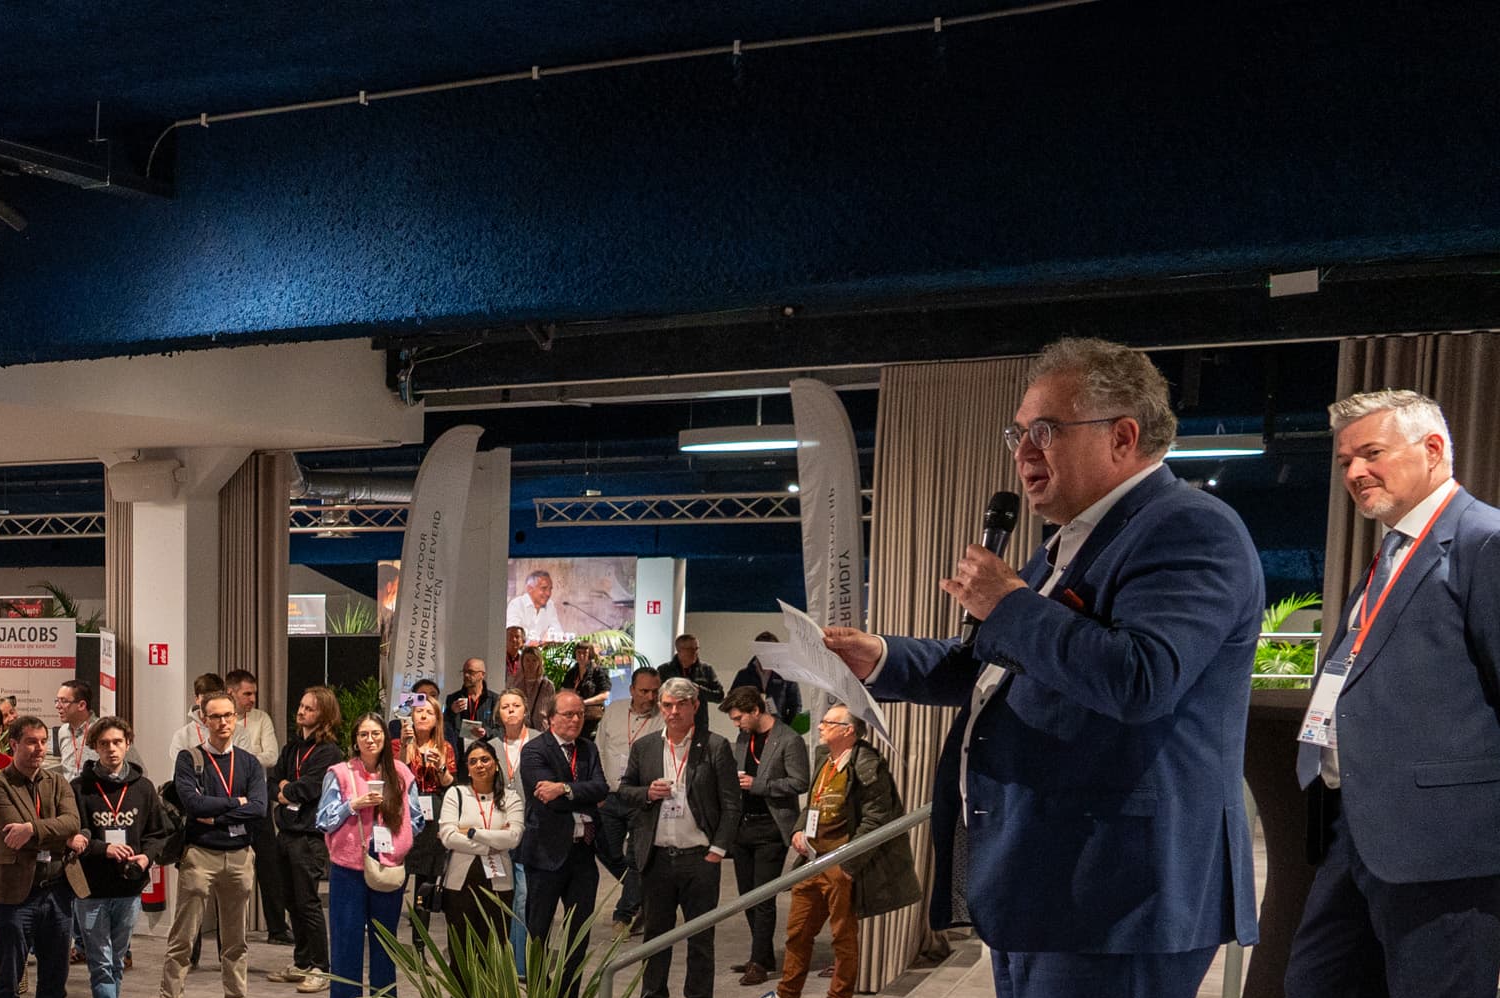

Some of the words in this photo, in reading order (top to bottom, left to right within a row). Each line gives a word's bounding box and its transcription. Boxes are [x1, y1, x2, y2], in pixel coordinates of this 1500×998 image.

[414, 533, 428, 597] KANTOOR
[427, 511, 442, 580] GELEVERD
[23, 658, 62, 668] SUPPLIES
